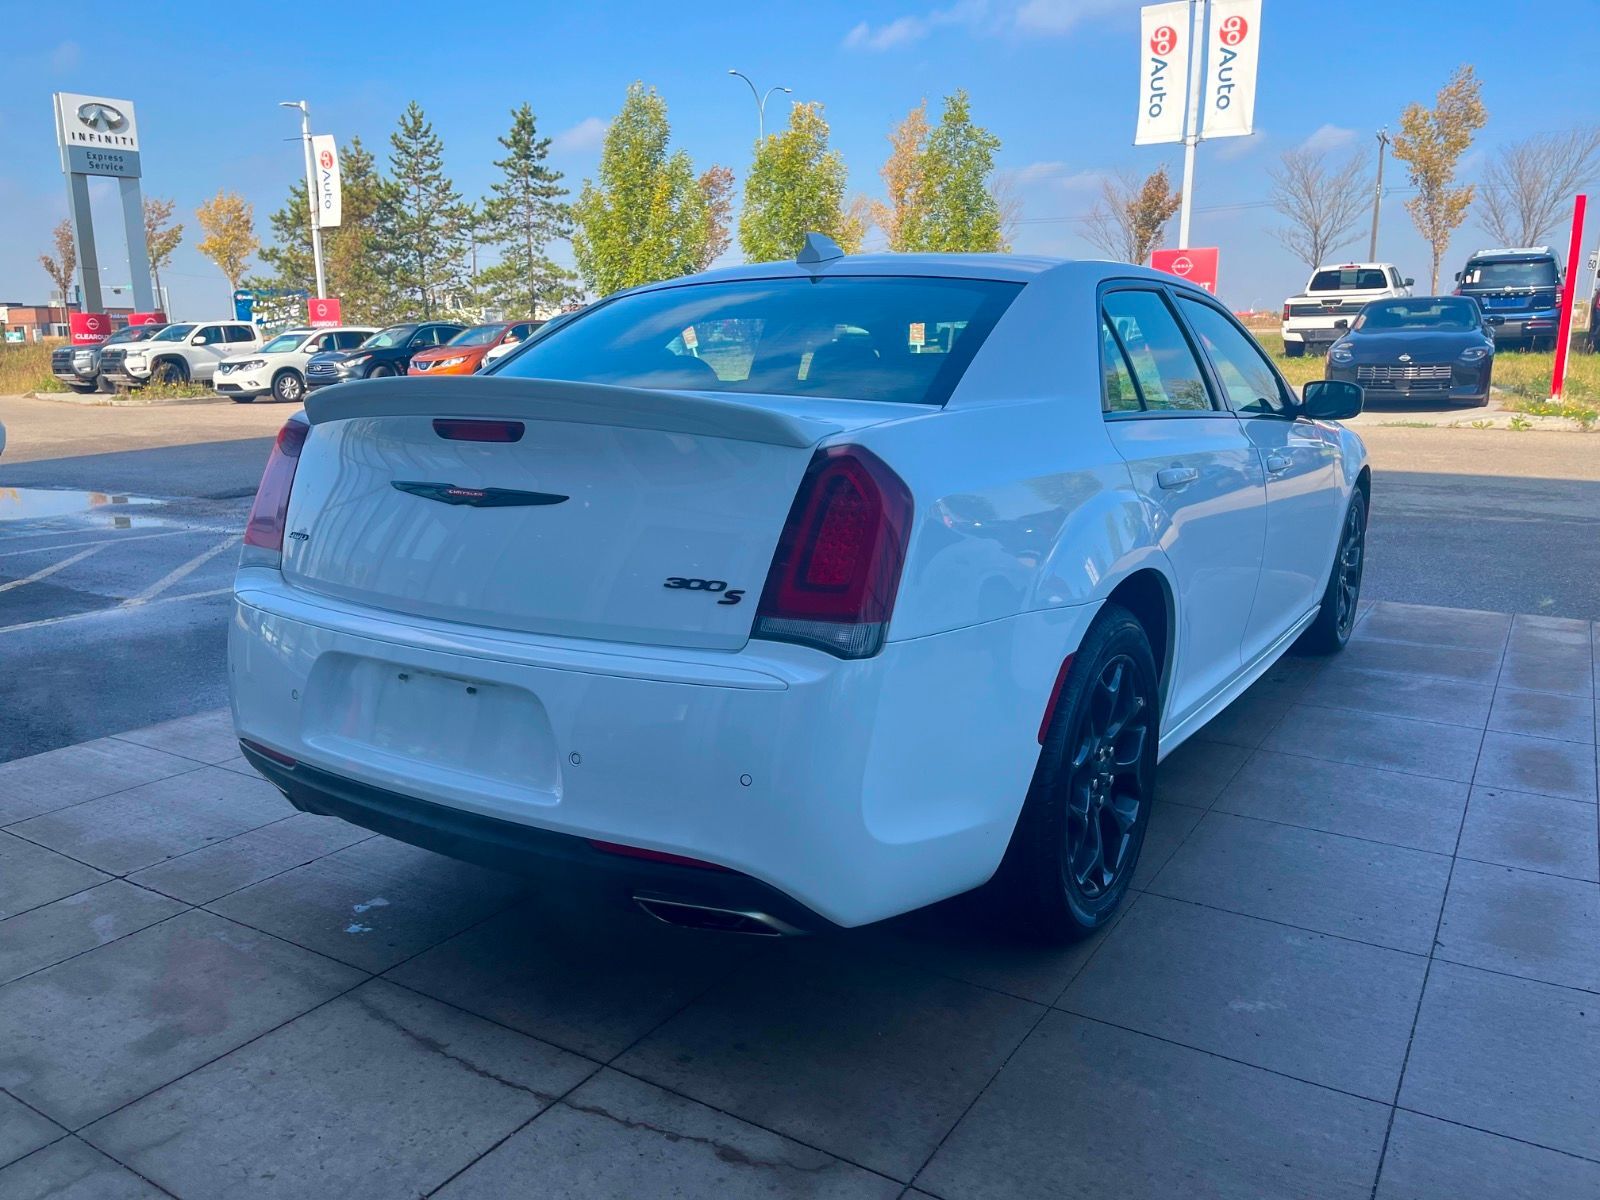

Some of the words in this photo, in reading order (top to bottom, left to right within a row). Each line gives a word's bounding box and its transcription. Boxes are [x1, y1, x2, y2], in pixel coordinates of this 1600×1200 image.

[1216, 47, 1237, 110] Auto
[1149, 57, 1168, 118] Auto
[71, 132, 134, 146] INFINITI
[86, 151, 124, 162] Express
[88, 161, 124, 172] Service
[322, 169, 333, 209] Auto
[448, 489, 483, 497] CHRYSLER
